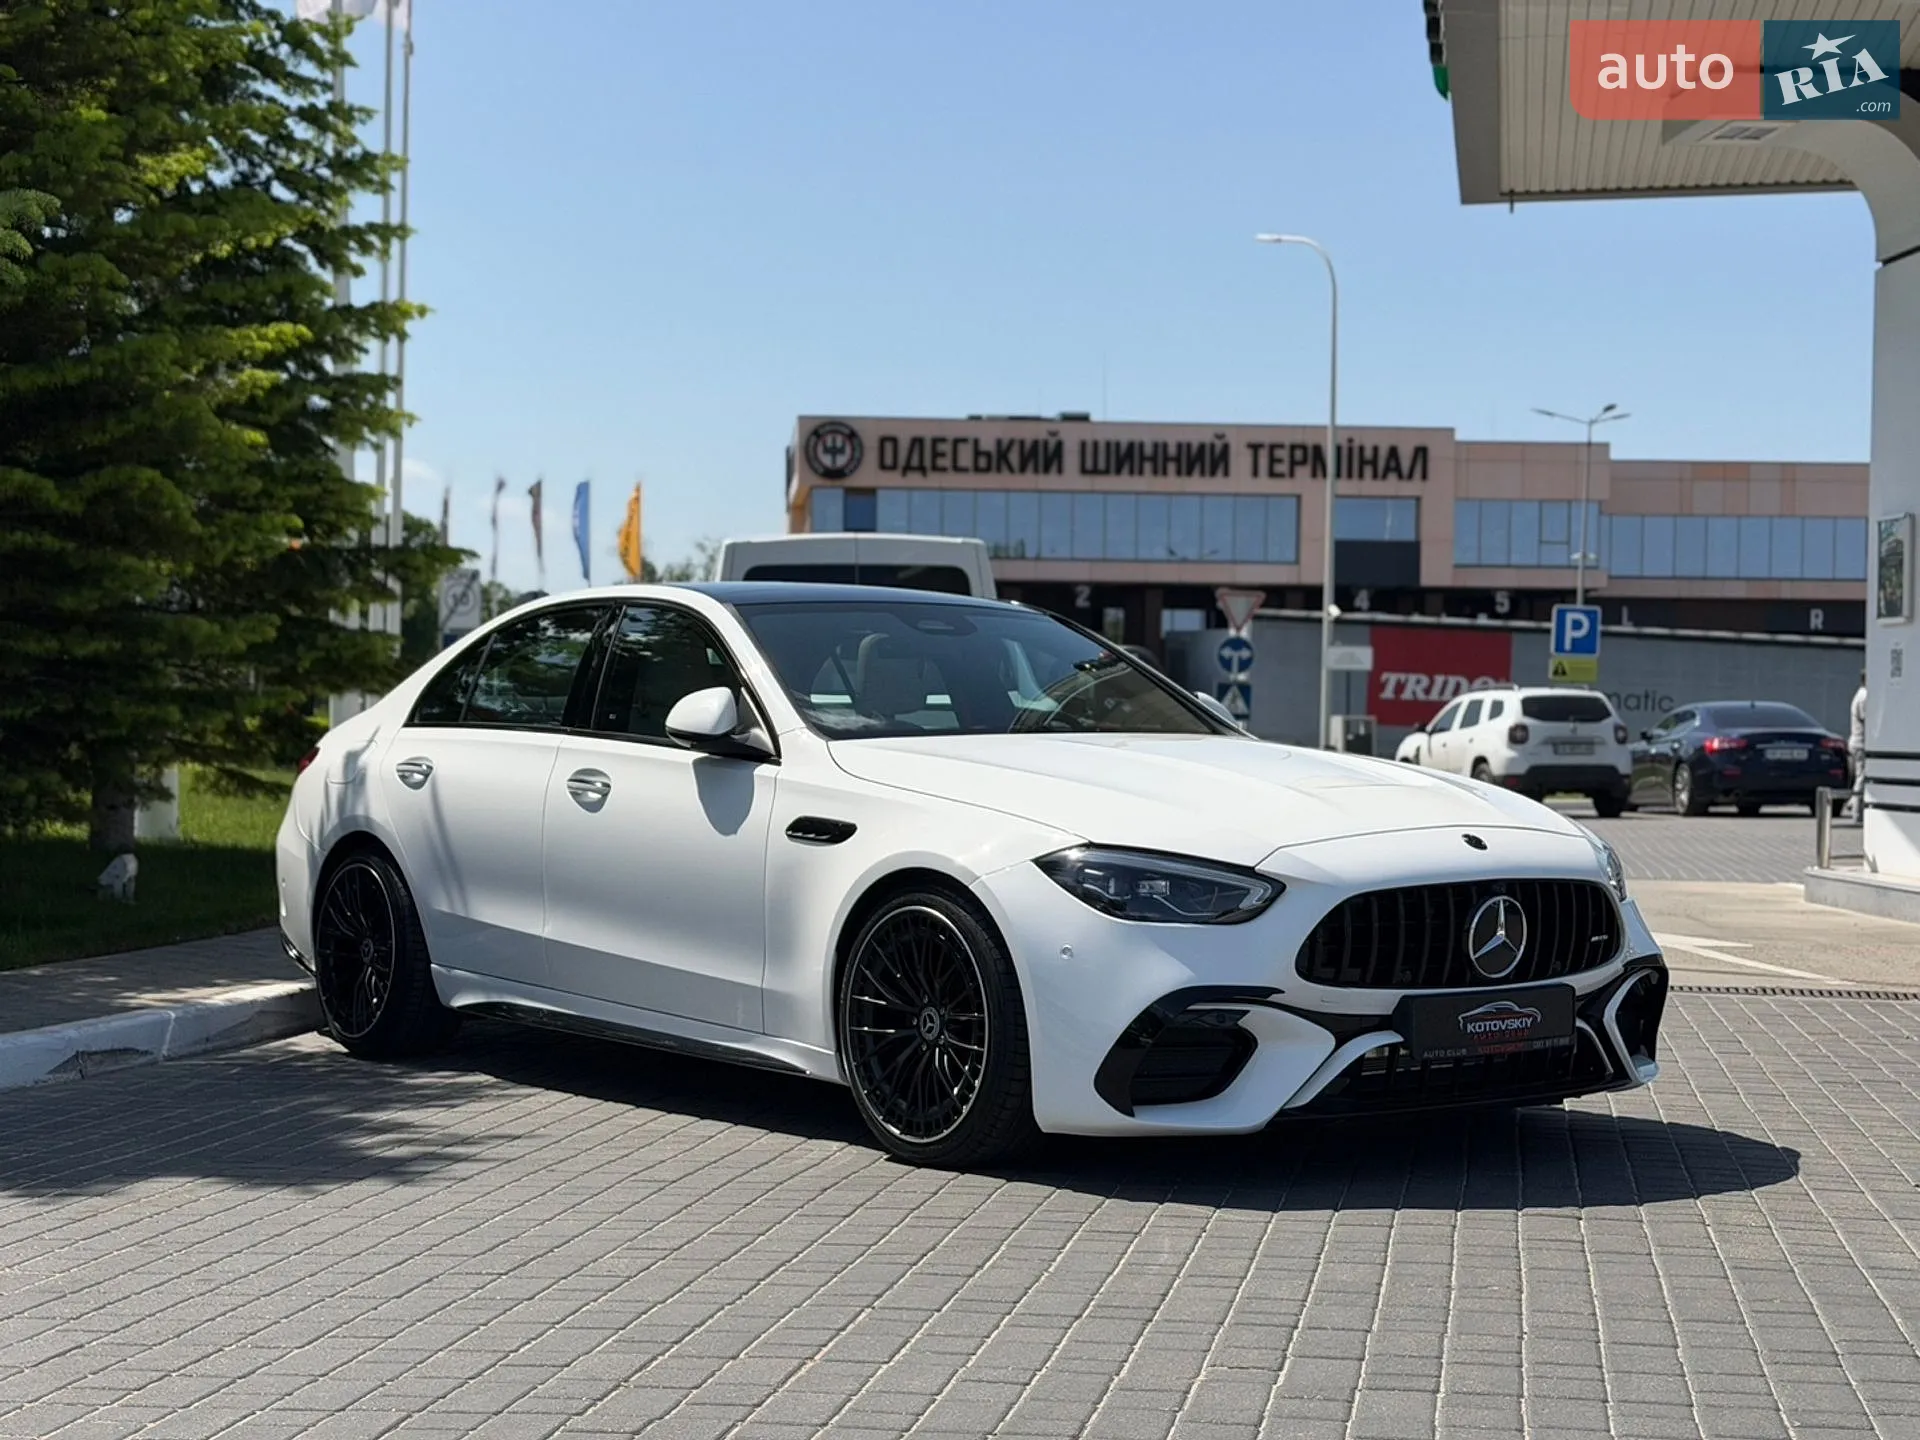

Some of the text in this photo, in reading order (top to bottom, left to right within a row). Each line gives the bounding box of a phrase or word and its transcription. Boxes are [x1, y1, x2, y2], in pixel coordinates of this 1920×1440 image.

[878, 430, 1064, 478] ОДЕСЬКИЙ
[1079, 433, 1231, 477] ШИННИЙ
[1246, 437, 1430, 481] ТЕРМІНАЛ
[1074, 585, 1091, 608] 2
[1352, 589, 1370, 611] 4
[1494, 590, 1511, 614] 5
[1809, 608, 1825, 630] R
[1563, 611, 1591, 651] P
[1467, 1016, 1533, 1034] KOTOVSKIY
[1423, 1048, 1446, 1058] AUTO
